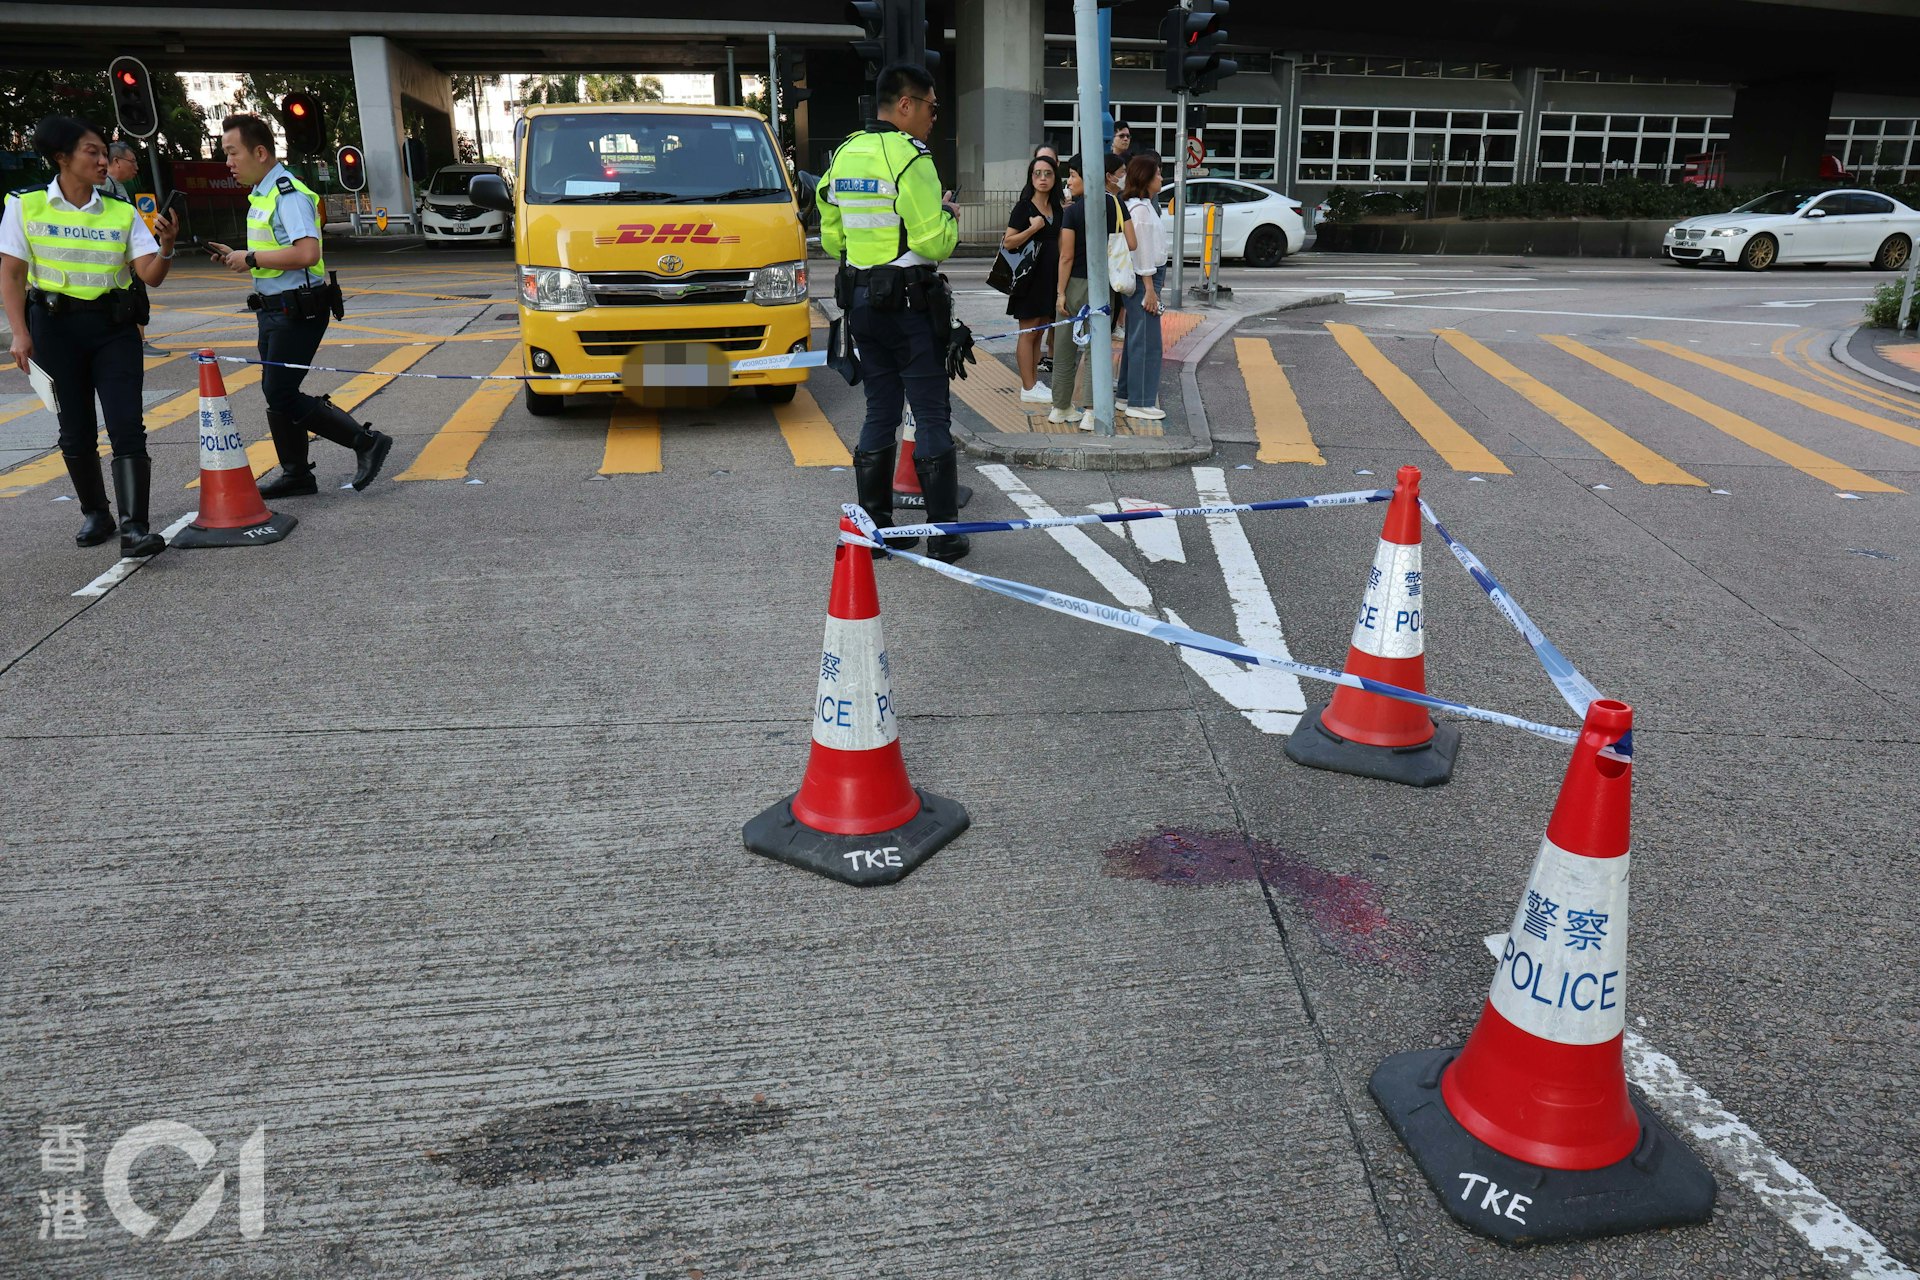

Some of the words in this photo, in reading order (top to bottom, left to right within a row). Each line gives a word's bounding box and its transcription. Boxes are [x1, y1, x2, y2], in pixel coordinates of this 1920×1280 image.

[840, 180, 865, 191] POLICE
[64, 227, 106, 240] POLICE
[615, 223, 721, 245] DHL
[200, 410, 234, 428] 警察
[200, 432, 243, 452] POLICE
[900, 496, 925, 506] TKE
[243, 526, 278, 539] TKE
[814, 694, 853, 728] ICE
[843, 846, 904, 872] TKE
[1523, 889, 1609, 951] 警察
[1500, 936, 1619, 1012] POLICE
[1458, 1172, 1533, 1226] TKE
